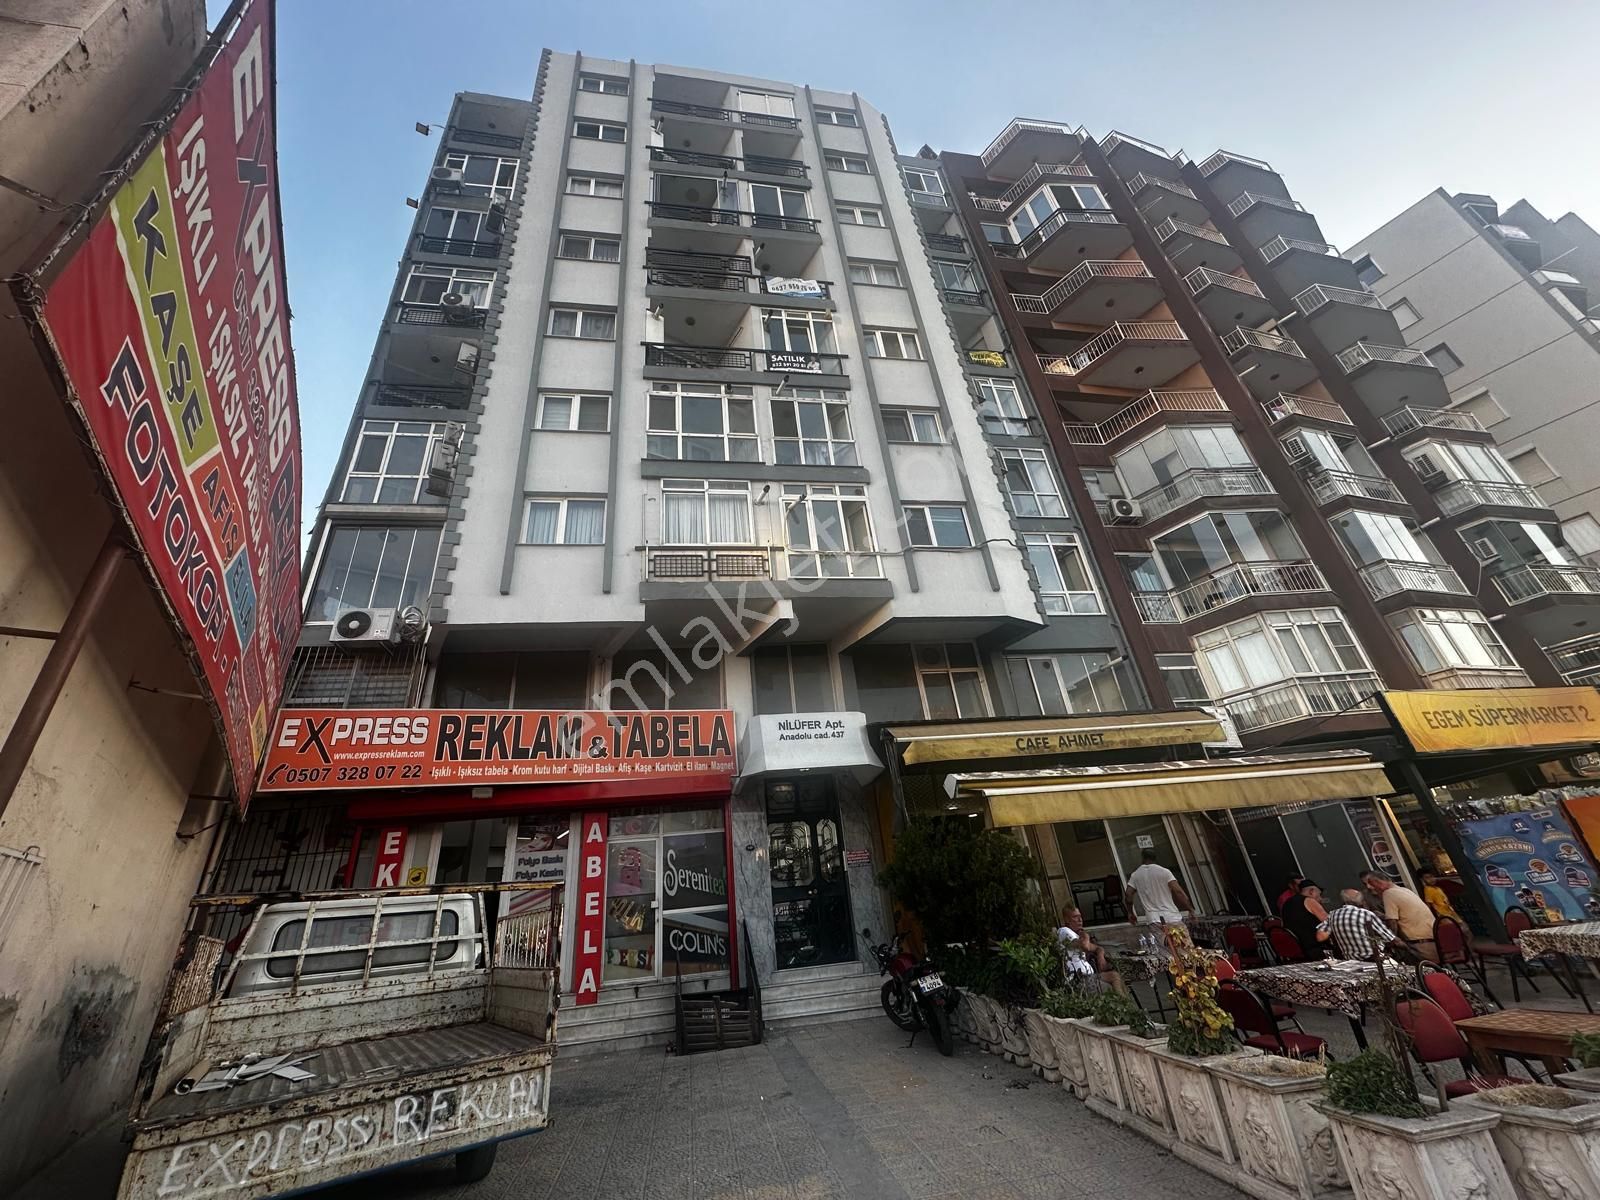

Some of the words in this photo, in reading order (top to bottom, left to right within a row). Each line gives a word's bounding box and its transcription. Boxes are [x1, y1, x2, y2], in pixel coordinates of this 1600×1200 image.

[233, 24, 291, 473] EXPRESS
[134, 187, 206, 450] KAŞE
[174, 115, 217, 295] IŞIKLI
[206, 307, 247, 459] IŞIKSIZ
[240, 436, 263, 552] TABELA
[233, 268, 253, 371] 0507
[248, 367, 265, 439] 328
[771, 354, 805, 363] SATILIK
[100, 335, 229, 662] FOTOKOPİ
[202, 466, 238, 568] AFİŞ
[778, 719, 821, 731] NİLÜFER
[825, 719, 845, 731] Apt.
[1421, 709, 1470, 730] EGEM
[1469, 704, 1580, 727] SÜPERMARKET
[1579, 704, 1595, 722] 2
[278, 716, 430, 764] EXPRESS
[433, 714, 583, 762] REKLAM
[588, 735, 609, 759] &
[607, 714, 733, 759] TABELA
[779, 732, 812, 741] Anadolu
[1015, 737, 1050, 752] CAFE
[1058, 733, 1105, 749] AHMET
[333, 749, 425, 762] www.expressreklam.com
[485, 764, 509, 776] tabela
[512, 764, 532, 775] Krom
[534, 763, 550, 775] kutu
[552, 763, 567, 775] harf
[573, 762, 593, 777] Dijital
[596, 763, 614, 773] Baskı
[618, 762, 632, 775] Afiş
[635, 762, 652, 775] Kaşe
[656, 761, 683, 773] Kartvizit
[711, 760, 734, 773] Magnet
[285, 767, 332, 784] 0507
[336, 766, 370, 782] 328
[375, 765, 397, 780] 07
[400, 765, 422, 779] 22
[515, 870, 537, 880] Folyo
[518, 857, 540, 867] Folyo
[664, 849, 725, 896] Serenitea
[669, 929, 726, 956] COLIN'S
